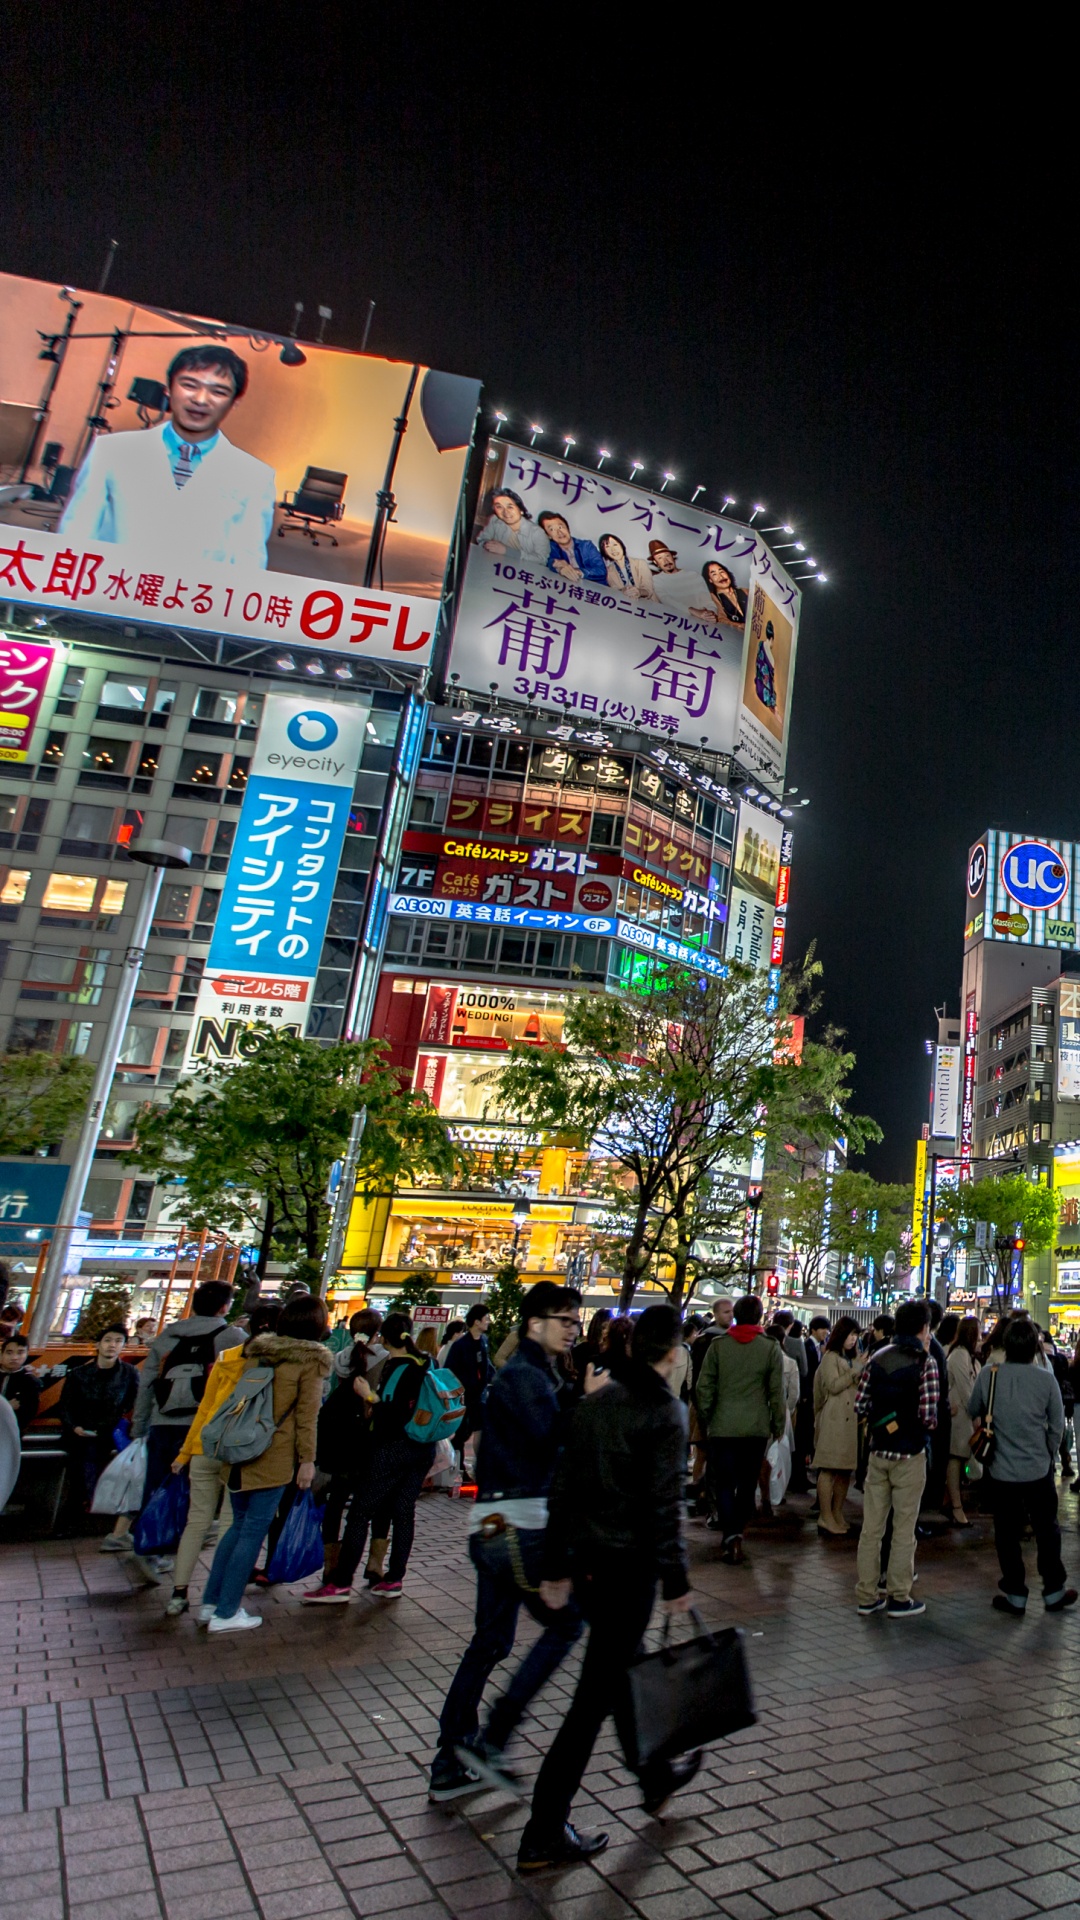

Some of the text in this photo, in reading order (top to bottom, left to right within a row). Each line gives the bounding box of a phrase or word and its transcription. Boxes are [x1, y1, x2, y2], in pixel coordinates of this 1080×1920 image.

[492, 561, 724, 643] 10年ぶり待望のニューアルバム
[267, 752, 346, 778] eyecity
[451, 799, 584, 836] プライス
[530, 848, 598, 876] ガスト
[625, 822, 707, 878] コンタクト
[230, 793, 299, 957] アイシティ
[278, 800, 335, 961] コンタクトの
[401, 866, 435, 887] 7F
[441, 886, 478, 897] レストラン
[442, 871, 567, 909] Café ガスト
[582, 894, 609, 904] ガスト
[683, 889, 720, 920] ガスト
[394, 897, 605, 931] AEON 英会話イーオン 6F
[993, 917, 1076, 938] MasterCard VISA
[620, 922, 726, 977] AEON 英会話イーオン
[222, 1003, 284, 1018] 利用者数
[457, 1008, 513, 1023] WEDDING!
[459, 993, 515, 1010] 1000%
